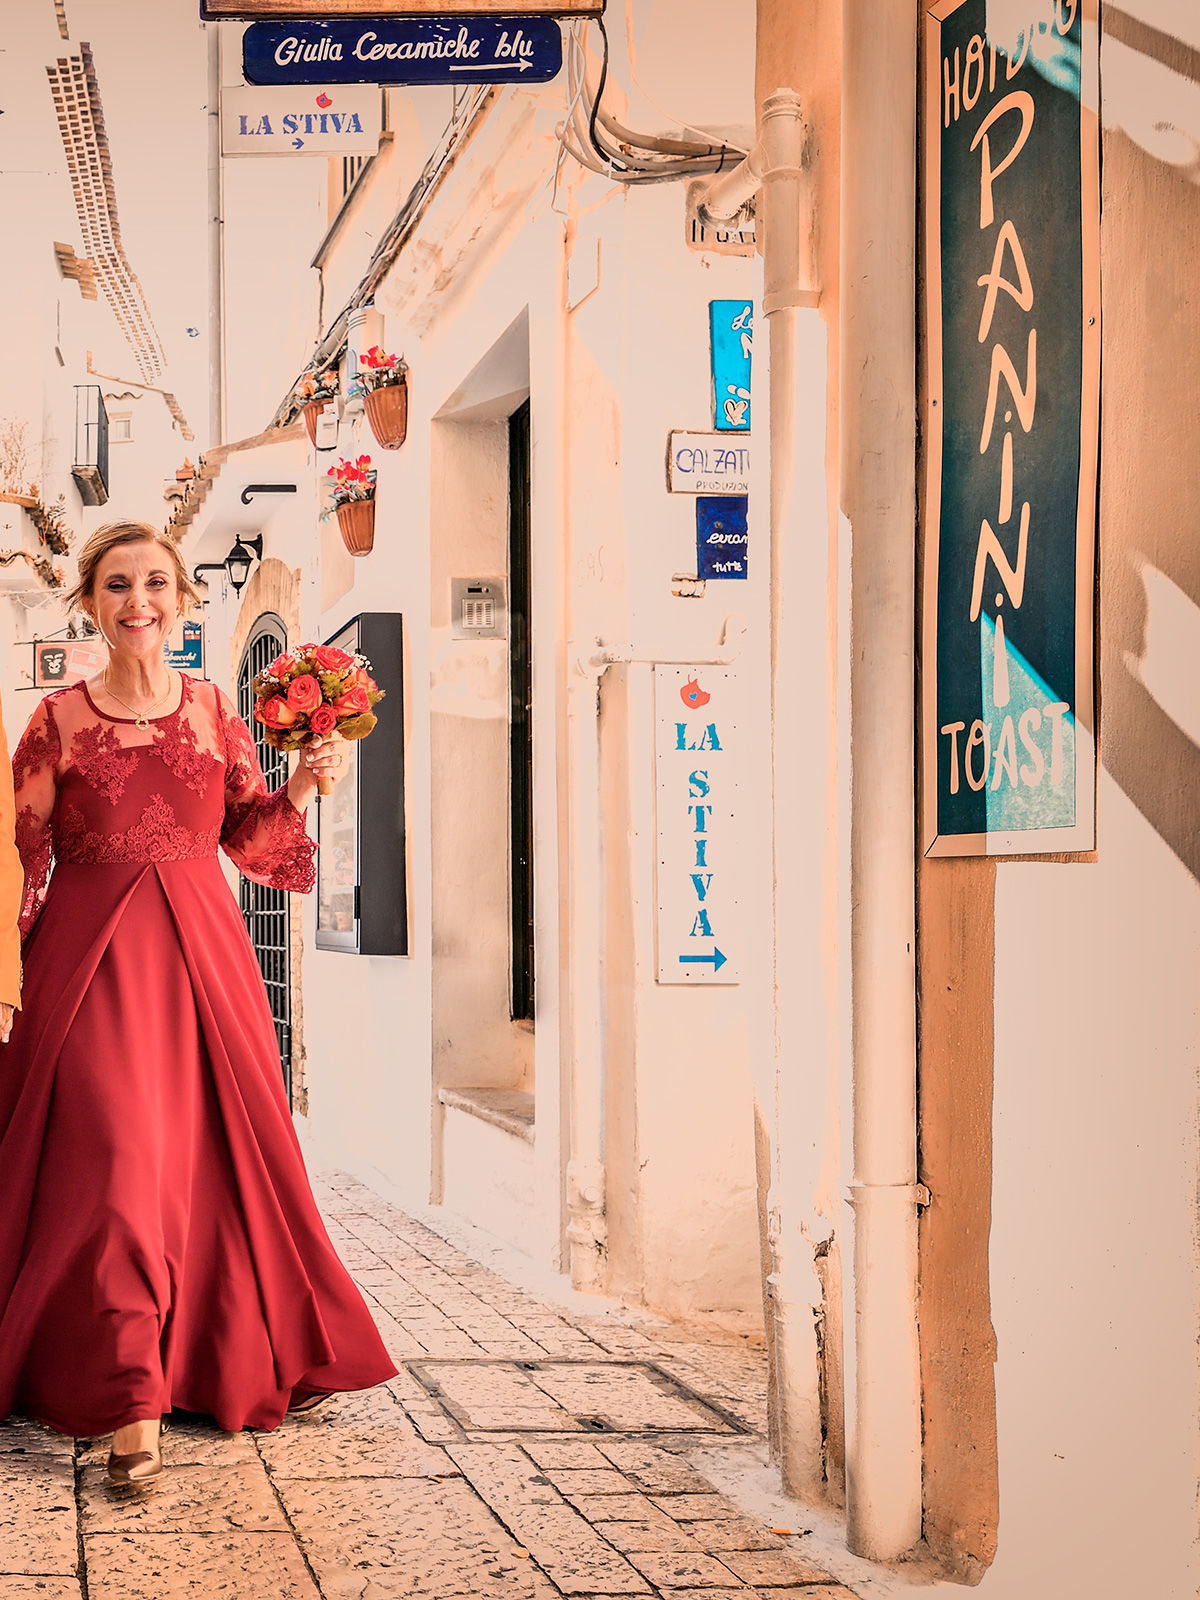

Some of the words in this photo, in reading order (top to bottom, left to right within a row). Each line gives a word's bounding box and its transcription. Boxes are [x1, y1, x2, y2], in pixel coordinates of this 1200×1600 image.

[274, 36, 343, 66] Giulia
[352, 27, 480, 61] Ceramiche
[494, 31, 534, 58] blu
[238, 115, 274, 135] LA
[282, 113, 363, 134] STIVA
[969, 90, 1037, 708] PANINI
[675, 448, 750, 475] CALZAT
[675, 722, 723, 751] LA
[941, 701, 1070, 795] TOAST
[688, 770, 715, 936] STIVA
